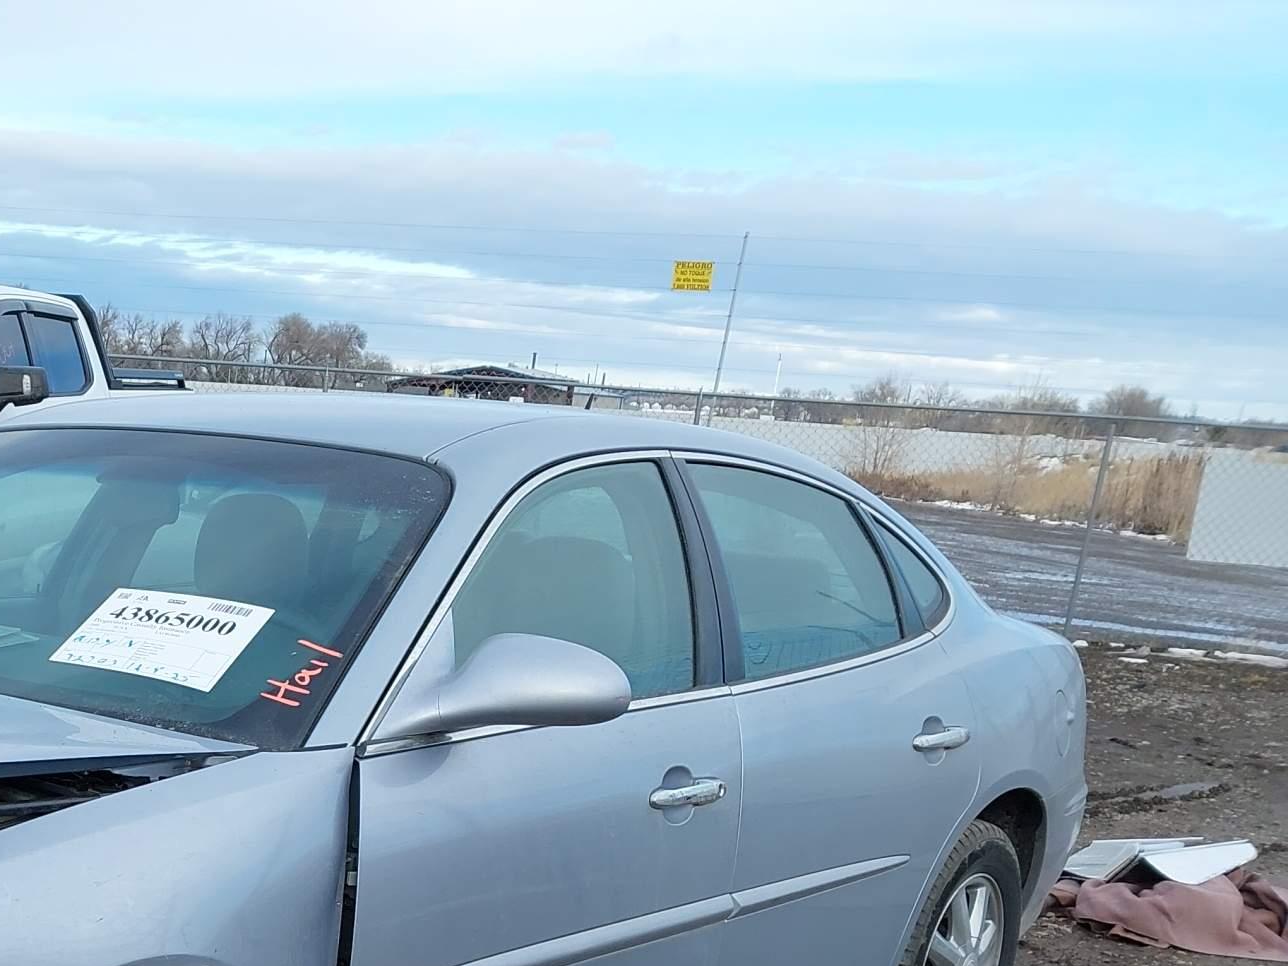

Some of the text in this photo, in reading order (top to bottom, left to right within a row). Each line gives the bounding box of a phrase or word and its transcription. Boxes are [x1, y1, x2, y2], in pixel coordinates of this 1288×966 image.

[676, 261, 713, 269] PELIGRO
[109, 605, 237, 636] 43865000
[260, 639, 344, 707] Hail
